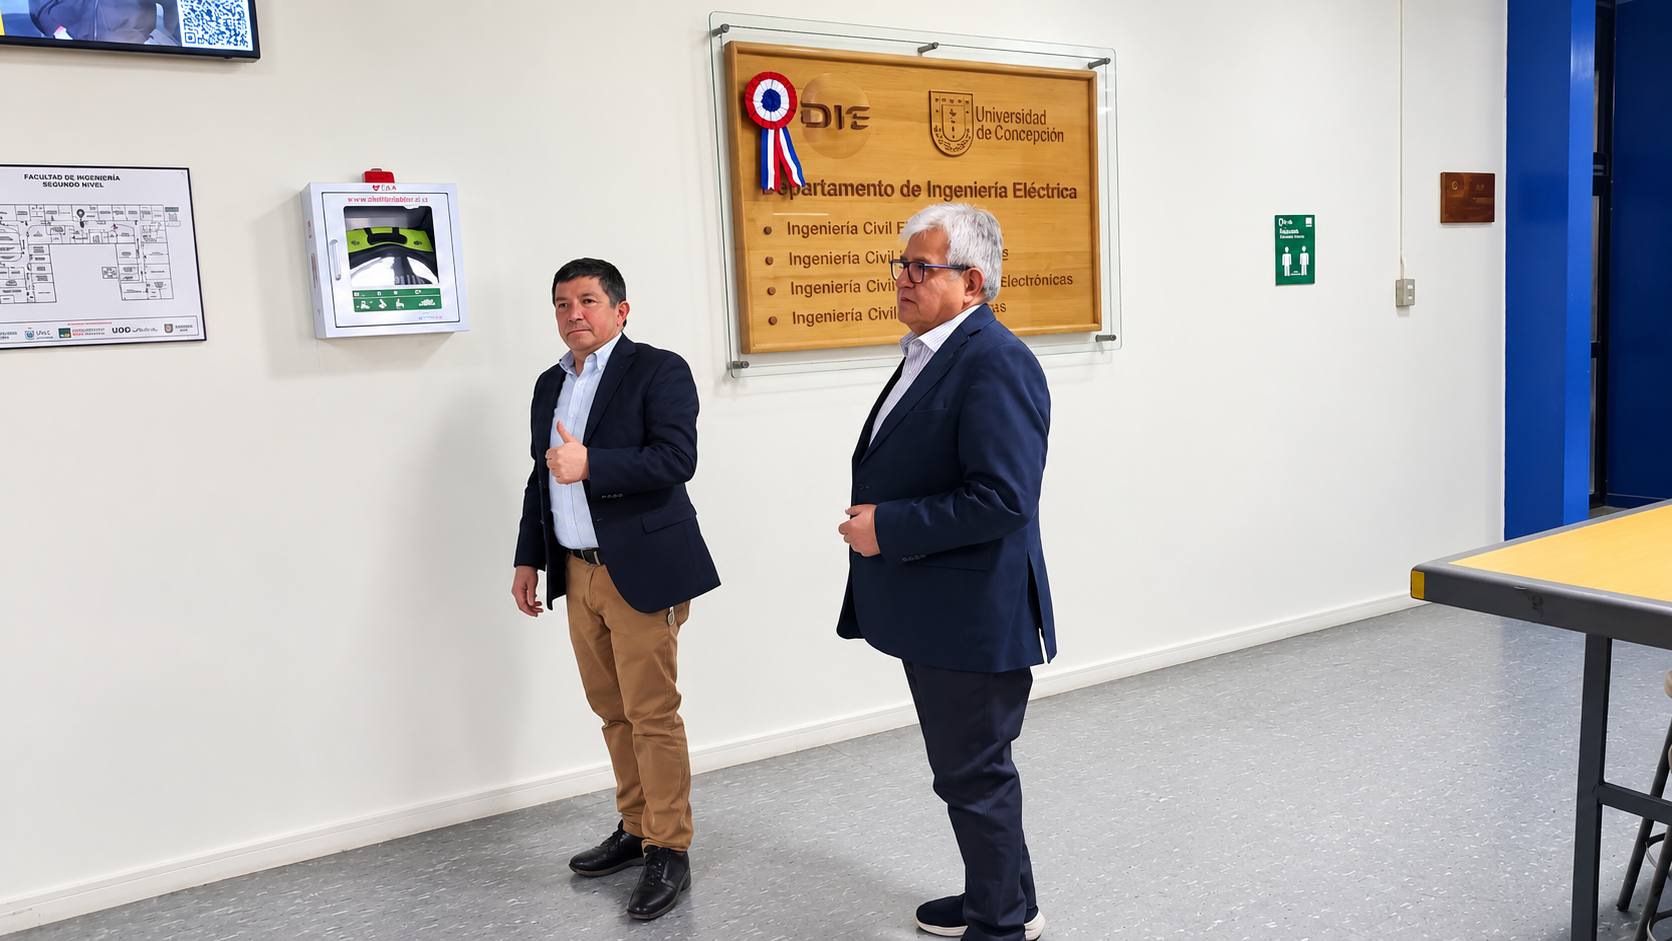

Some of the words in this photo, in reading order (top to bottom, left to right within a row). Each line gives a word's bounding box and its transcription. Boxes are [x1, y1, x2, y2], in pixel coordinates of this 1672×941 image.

[801, 102, 870, 130] DIE
[976, 106, 1046, 125] Universidad
[976, 125, 992, 140] de
[995, 125, 1064, 145] Concepción
[900, 179, 921, 197] de
[927, 180, 1008, 202] Ingeniería
[1012, 181, 1077, 199] Eléctrica
[787, 221, 858, 239] Ingeniería
[863, 221, 892, 235] Civil
[789, 251, 860, 269] Ingeniería
[865, 250, 894, 264] Civil
[791, 280, 861, 298] Ingeniería
[866, 278, 895, 292] Civil
[1001, 273, 1074, 288] Electrónicas
[792, 308, 862, 327] Ingeniería
[868, 306, 897, 320] Civil
